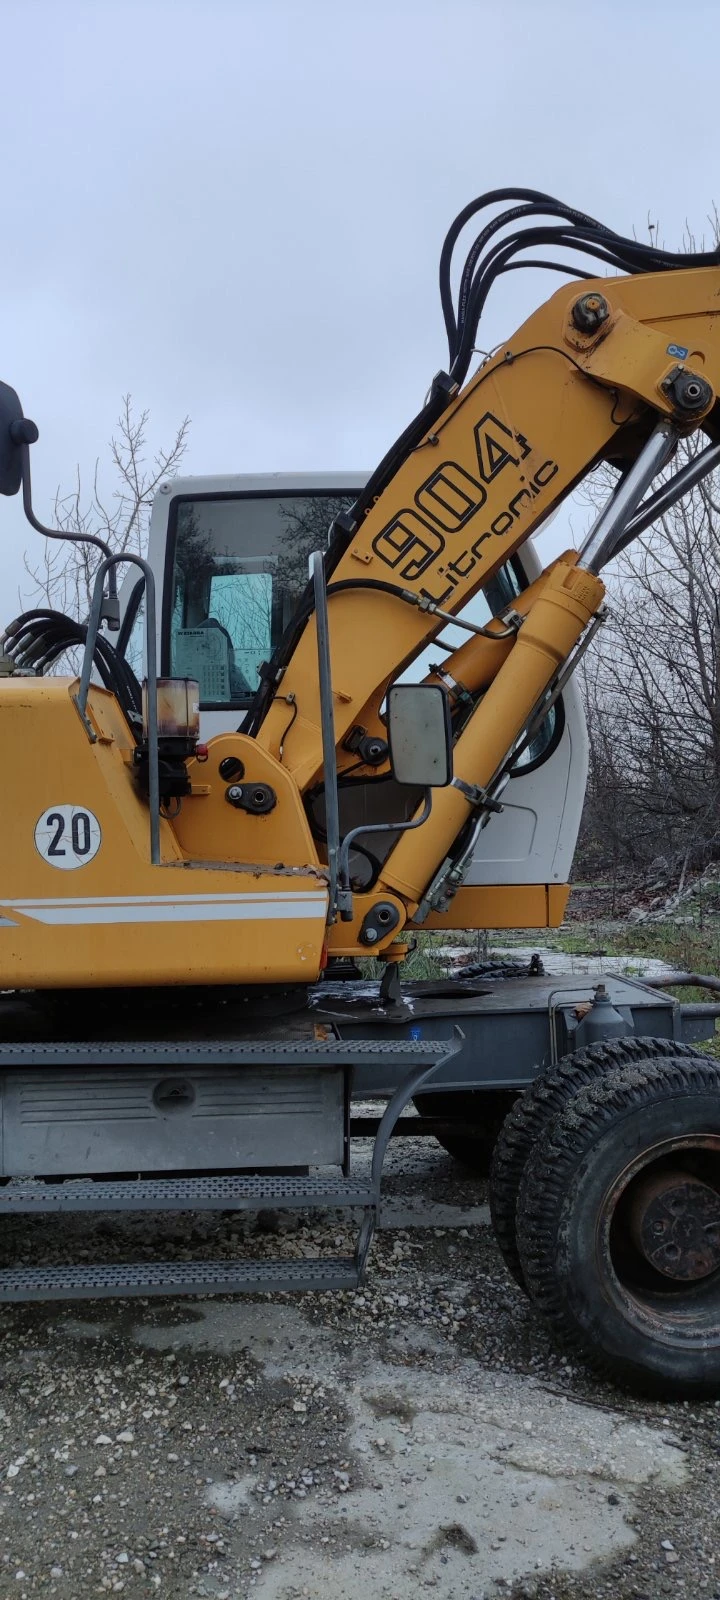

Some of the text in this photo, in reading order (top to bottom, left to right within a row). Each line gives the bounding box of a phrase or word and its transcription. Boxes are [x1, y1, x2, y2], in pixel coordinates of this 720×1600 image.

[372, 411, 532, 581] 904
[418, 460, 559, 605] Litronic
[46, 812, 91, 856] 20
